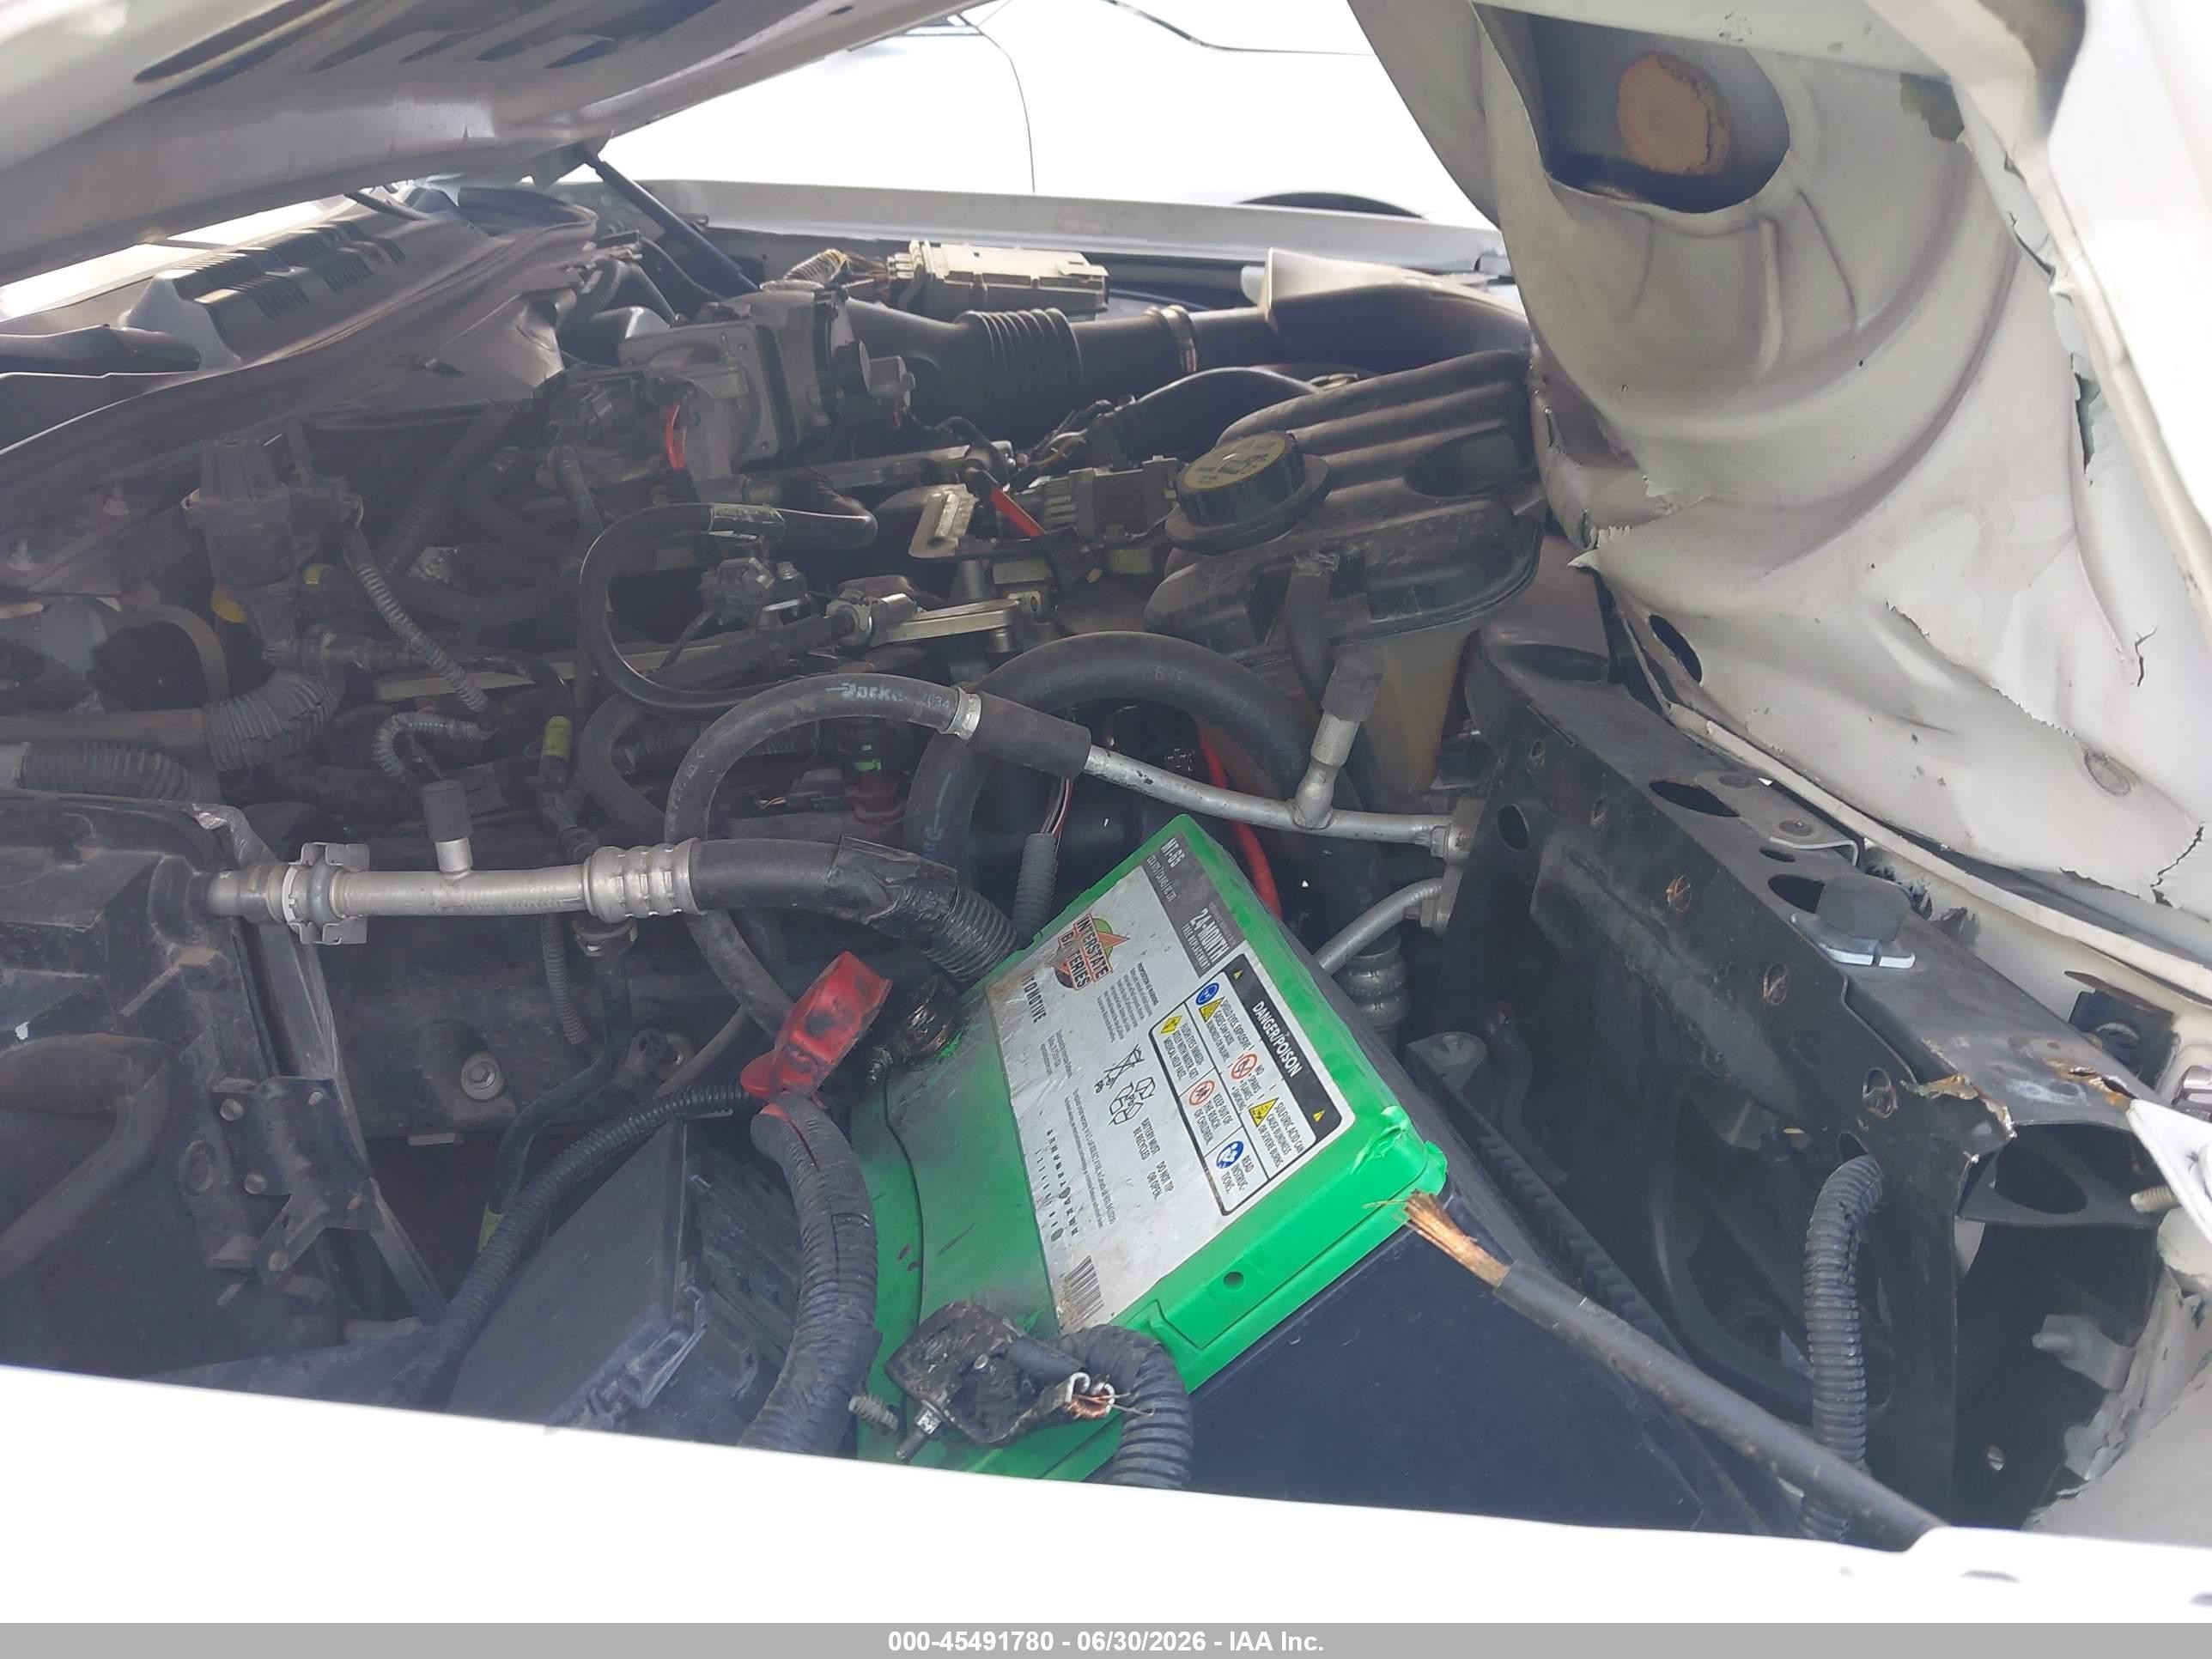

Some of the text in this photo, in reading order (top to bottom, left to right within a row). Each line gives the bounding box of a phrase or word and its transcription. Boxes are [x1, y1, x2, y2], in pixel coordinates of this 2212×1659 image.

[1160, 836, 1185, 868] MT-65
[1076, 916, 1112, 981] INTERSTATE
[1189, 907, 1230, 963] 24-MONTH
[1060, 930, 1092, 989] BTERIES
[1180, 1022, 1192, 1039] FLUSH
[1186, 1035, 1196, 1048] EYES
[1212, 1009, 1235, 1046] GASES CAN CAUSE
[1219, 1000, 1233, 1017] SHIELD
[1232, 1024, 1251, 1050] EXPLOSIVE
[1252, 1000, 1302, 1079] DANGER/POISON
[1163, 1036, 1177, 1058] MEDICAL
[1170, 1054, 1182, 1069] HELP
[1176, 1041, 1187, 1055] WITH
[1188, 1066, 1198, 1079] GET
[1094, 1079, 1104, 1093] Pb
[1248, 1074, 1261, 1093] SPARKS
[1254, 1064, 1265, 1076] NO
[1231, 1088, 1245, 1111] SMOKING
[1239, 1081, 1252, 1100] FLAMES
[1202, 1100, 1221, 1130] THE REACH
[1212, 1092, 1232, 1126] KEEP OUT OF
[1133, 1126, 1150, 1161] BE RECYCLED
[1140, 1117, 1159, 1155] BATTERY MUST
[1194, 1108, 1214, 1145] OF CHILDREN.
[1266, 1113, 1291, 1155] CAUSE BLINDNESS
[1274, 1102, 1304, 1153] SULFURIC ACID CAN
[1257, 1123, 1284, 1168] OR SEVERE BURNS.
[1146, 1170, 1156, 1183] OR
[1156, 1160, 1174, 1194] DO NOT TIP
[1231, 1163, 1248, 1191] INSTRUC-
[1241, 1155, 1254, 1173] READ
[1220, 1171, 1235, 1193] TIONS.
